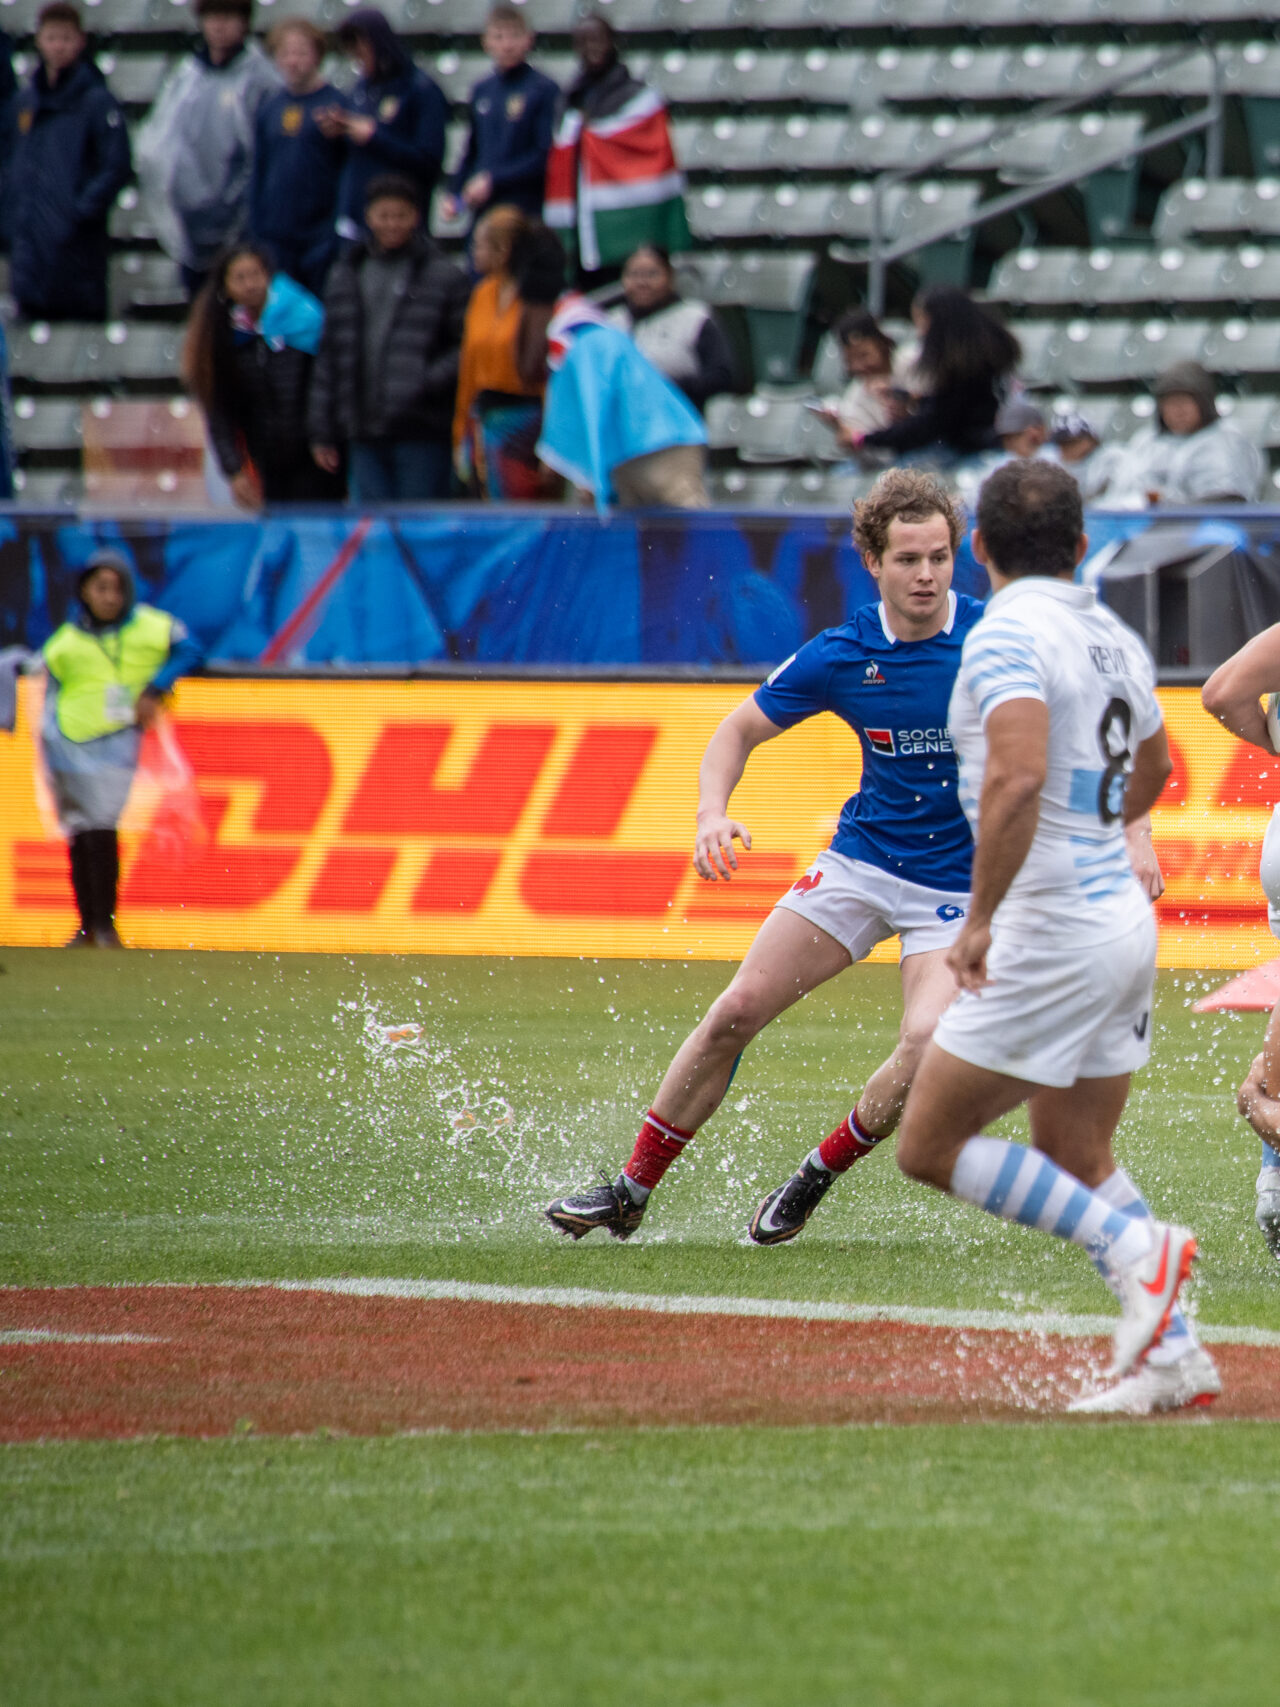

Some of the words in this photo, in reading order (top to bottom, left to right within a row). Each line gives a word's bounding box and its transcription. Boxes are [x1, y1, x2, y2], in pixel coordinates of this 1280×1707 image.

[900, 741, 952, 754] GENE
[1097, 697, 1132, 827] 8
[120, 718, 694, 922] DHL
[936, 903, 965, 924] 6
